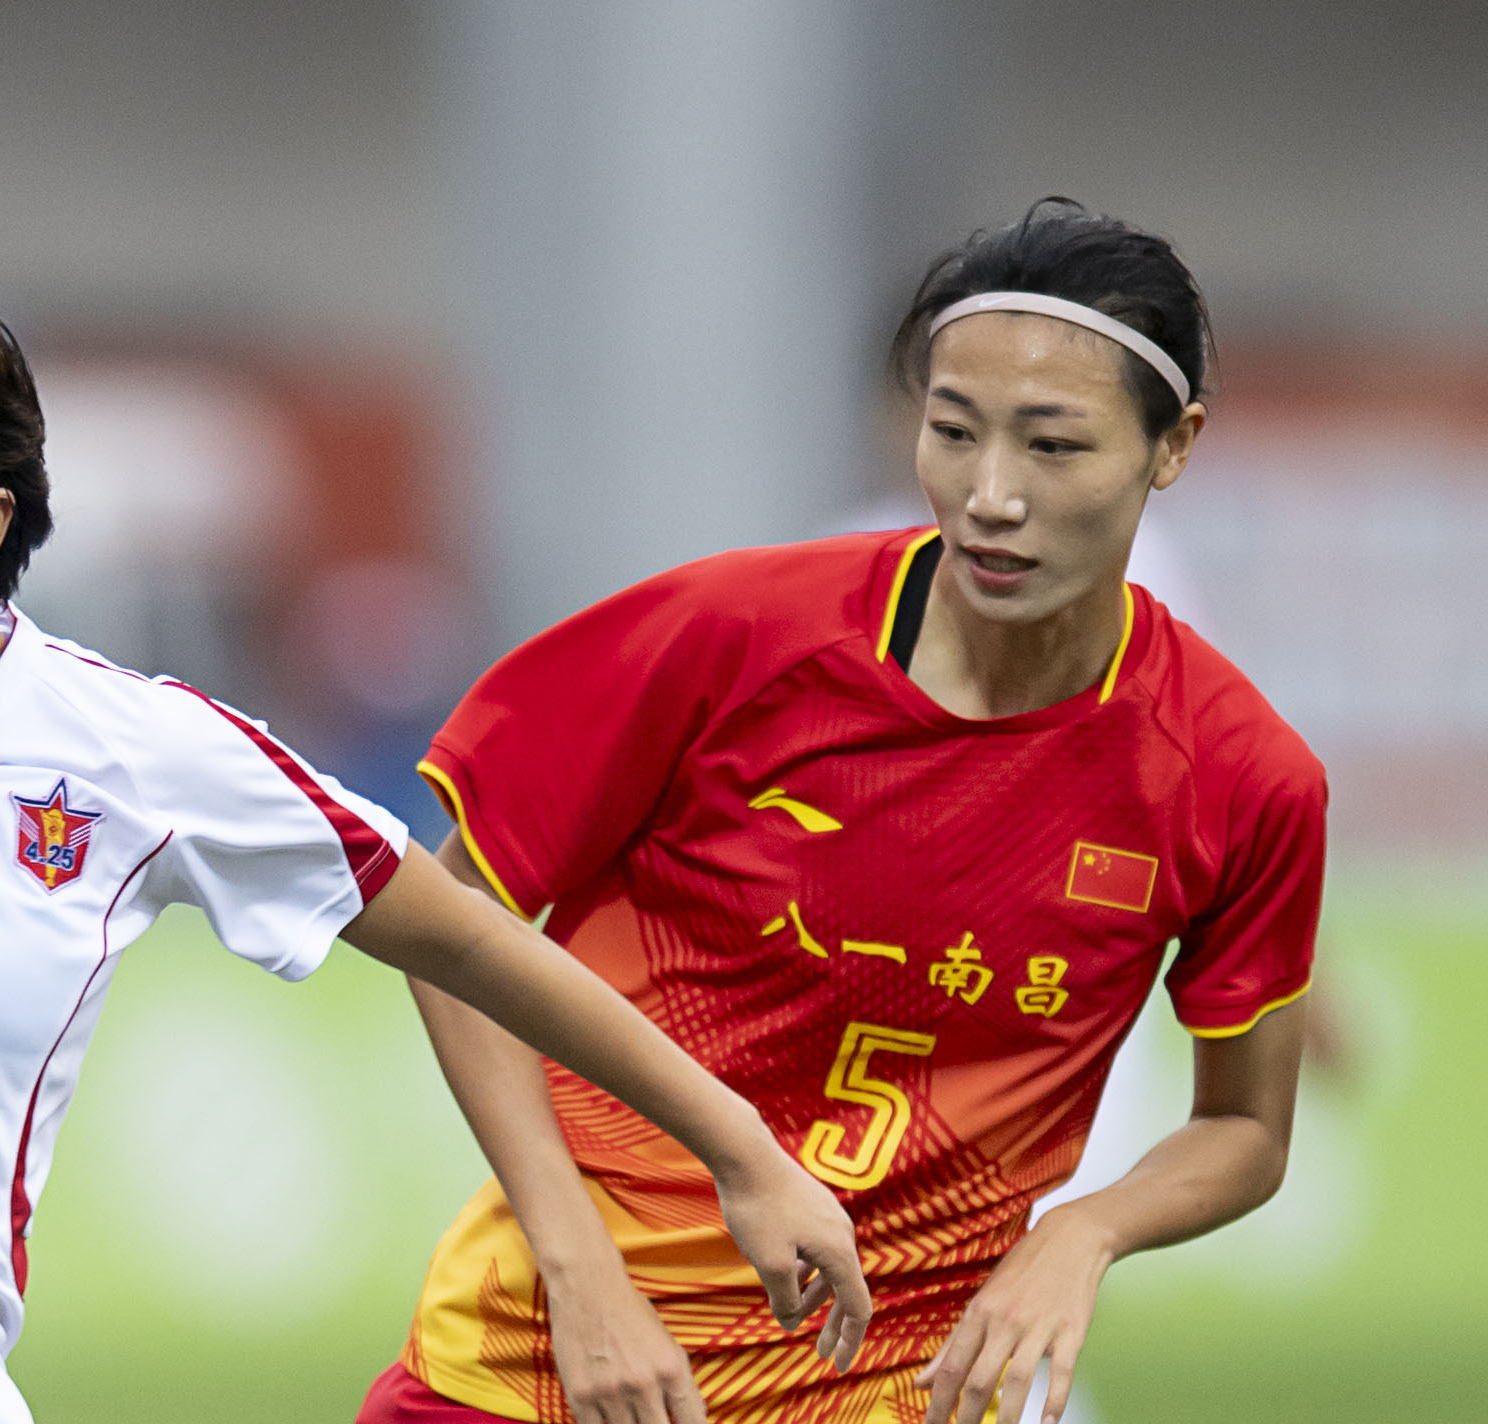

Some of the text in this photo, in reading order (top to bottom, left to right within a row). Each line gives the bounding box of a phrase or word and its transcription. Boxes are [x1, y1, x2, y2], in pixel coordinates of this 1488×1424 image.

[26, 841, 75, 871] 4.25
[761, 901, 1069, 1018] 八一南昌
[800, 1020, 936, 1190] 5
